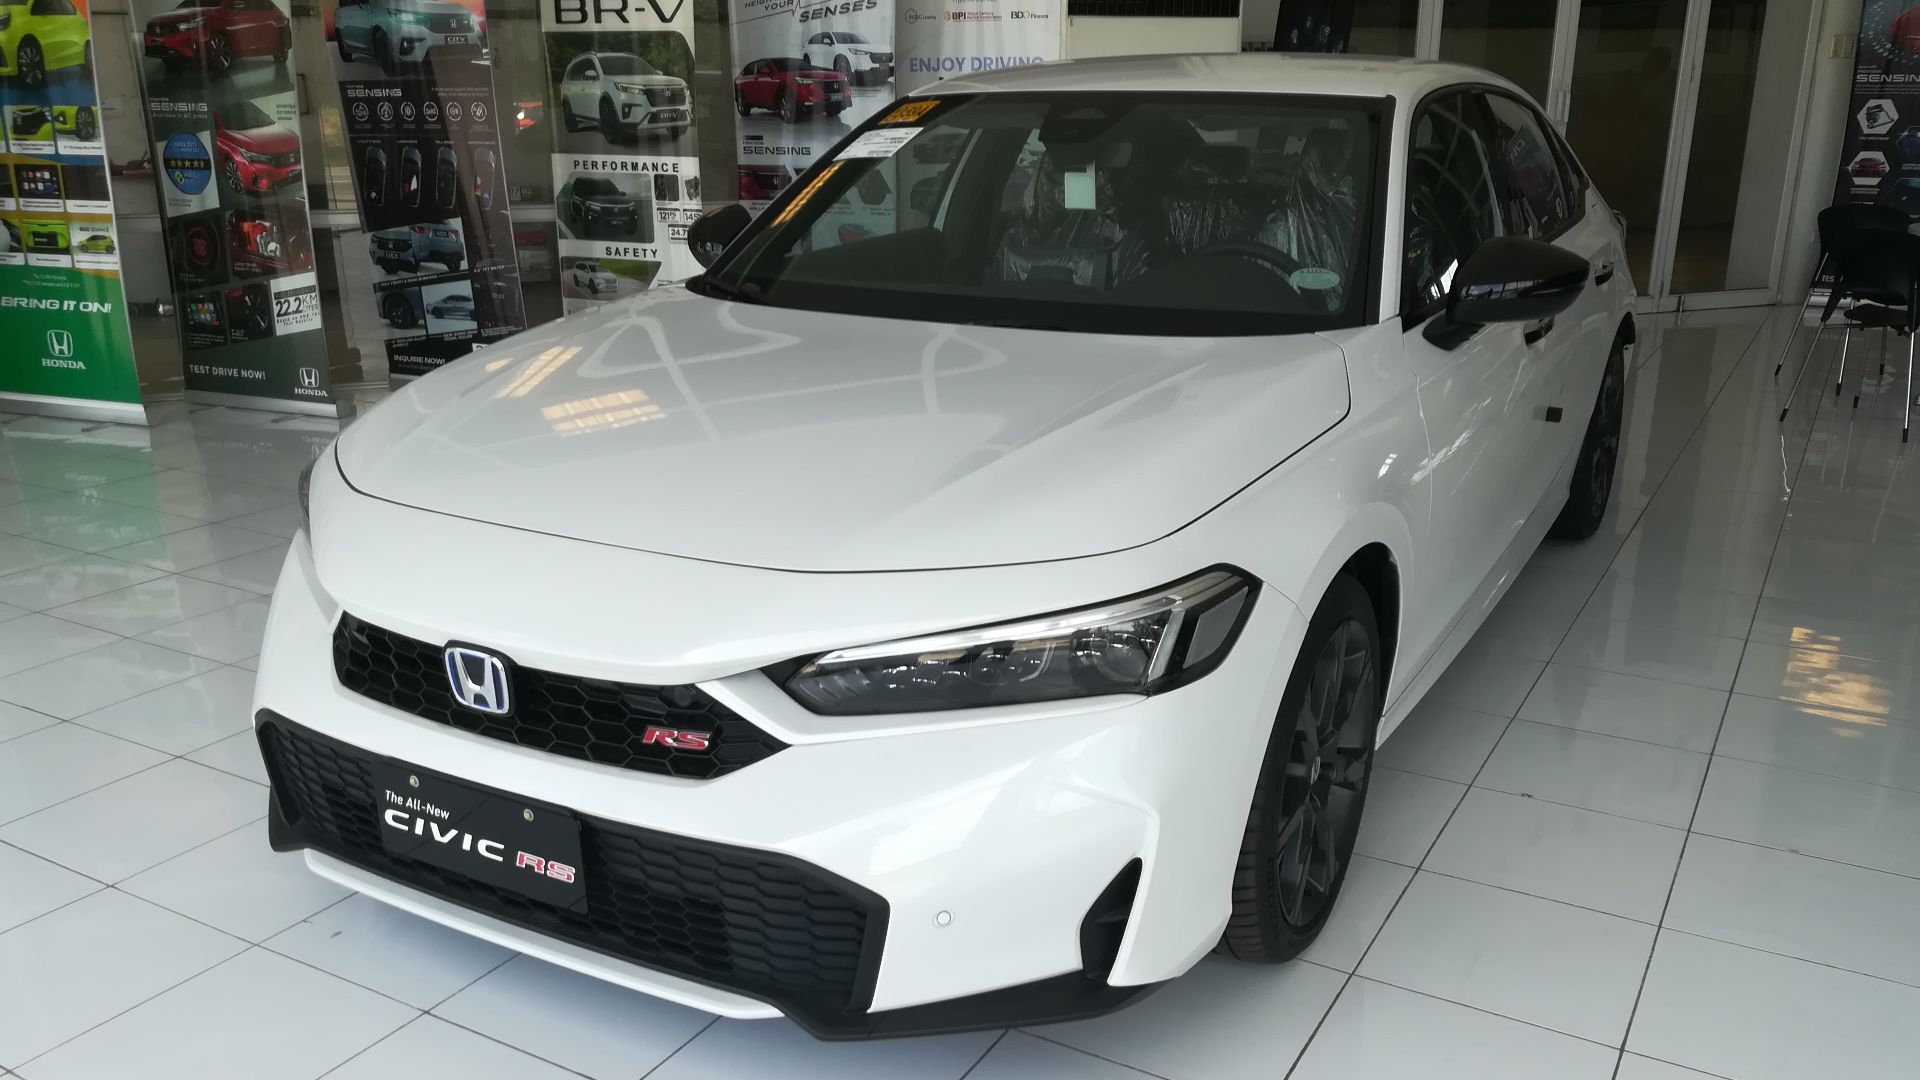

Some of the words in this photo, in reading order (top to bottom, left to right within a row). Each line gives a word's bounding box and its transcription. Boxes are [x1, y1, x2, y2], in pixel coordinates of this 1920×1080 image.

[554, 0, 685, 24] BR-V
[799, 0, 878, 23] SENSES
[952, 11, 966, 20] BPI
[1011, 11, 1030, 19] BDO
[909, 56, 965, 72] ENJOY
[347, 88, 403, 97] SENSING
[150, 102, 208, 112] SENSING
[743, 146, 811, 156] SENSING
[573, 159, 680, 173] PERFORMANCE
[605, 246, 658, 258] SAFETY
[1, 296, 60, 310] BRING
[63, 300, 77, 311] IT
[79, 301, 112, 313] ON!
[275, 296, 303, 318] 22.2
[302, 293, 318, 306] KM
[41, 358, 87, 370] HONDA
[394, 354, 424, 363] INQUIRE
[425, 357, 446, 365] NOW!
[189, 364, 211, 374] TEST
[212, 366, 239, 377] DRIVE
[241, 369, 267, 380] NOW!
[294, 387, 328, 397] HONDA
[641, 726, 712, 751] RS
[385, 789, 404, 806] The
[405, 794, 450, 820] All-New
[384, 808, 505, 862] CIVIC
[515, 850, 576, 884] RS
